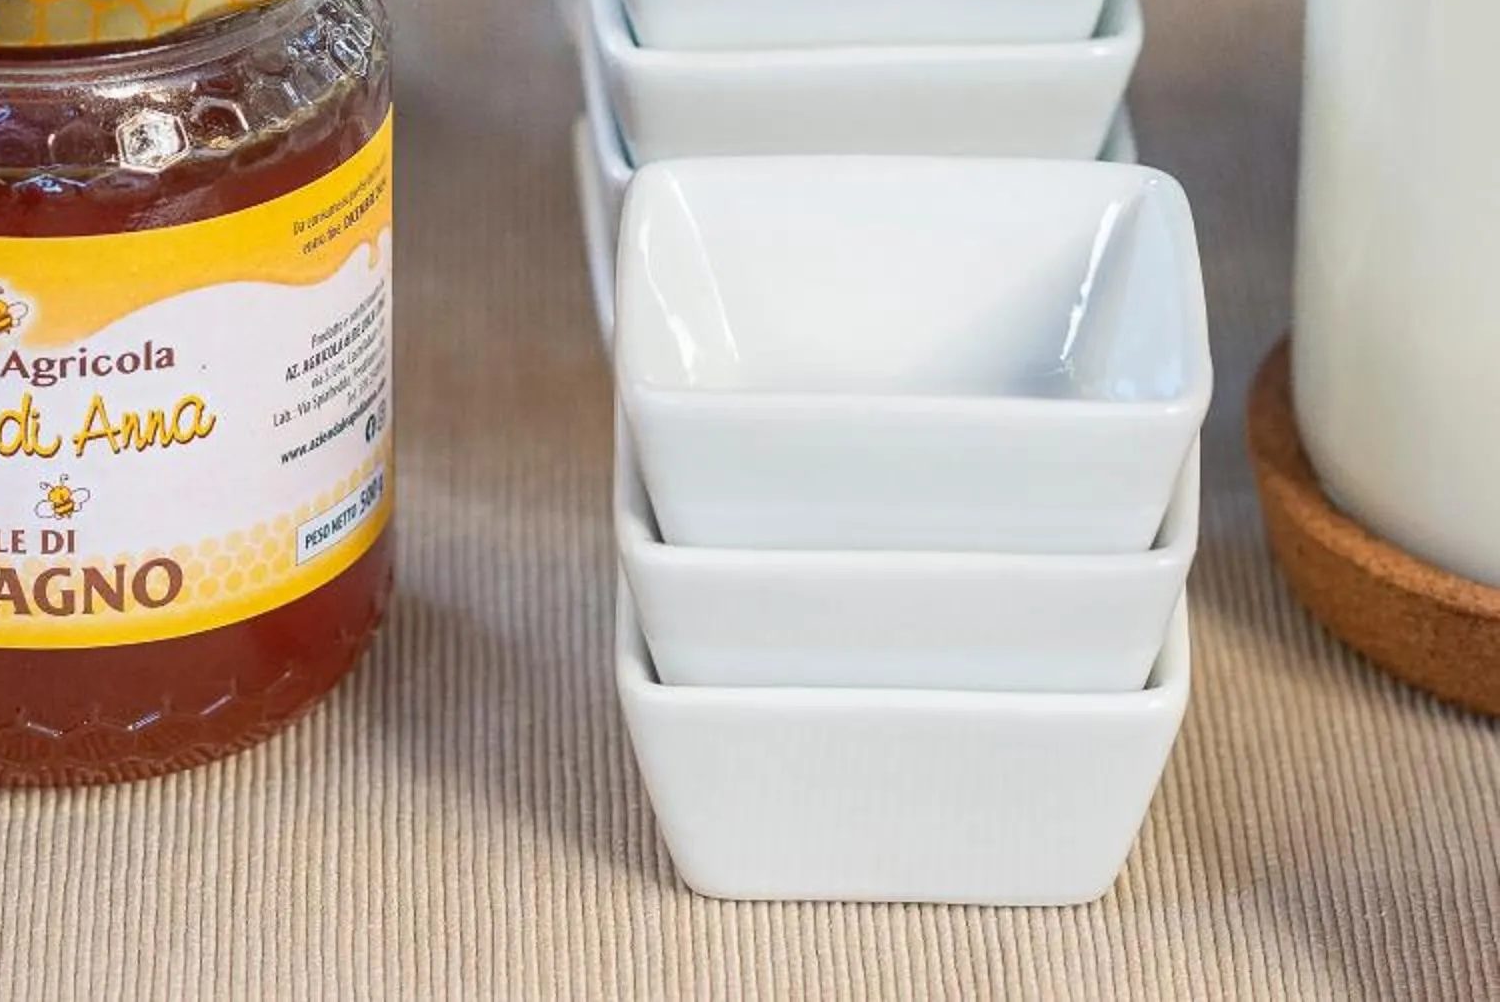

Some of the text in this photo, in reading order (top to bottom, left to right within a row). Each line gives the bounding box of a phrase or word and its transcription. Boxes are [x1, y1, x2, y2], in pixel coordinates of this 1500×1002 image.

[0, 340, 175, 388] Agricola
[72, 392, 217, 458] Anna
[40, 529, 76, 555] DI
[305, 523, 331, 550] PESO
[331, 503, 357, 535] NETTO
